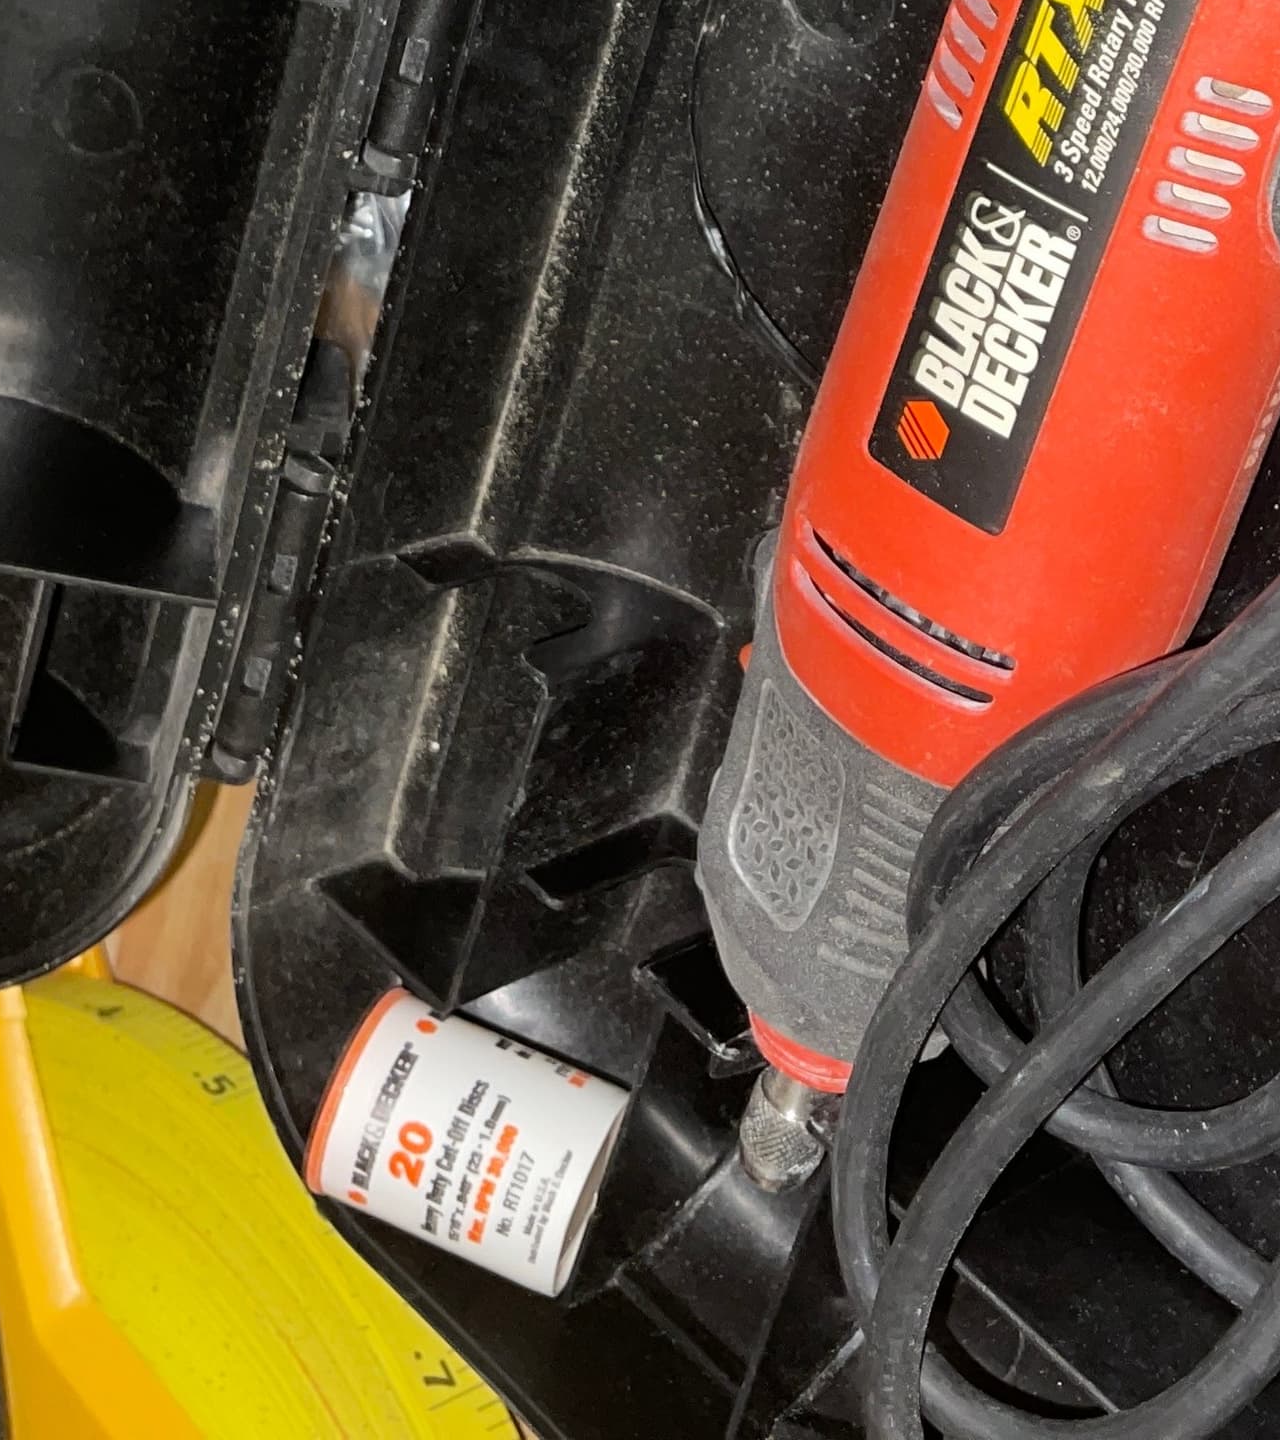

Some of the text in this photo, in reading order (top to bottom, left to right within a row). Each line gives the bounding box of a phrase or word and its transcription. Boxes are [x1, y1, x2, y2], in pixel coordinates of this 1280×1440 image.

[1089, 9, 1132, 88] Rotary
[1061, 85, 1101, 163] Speed
[1082, 19, 1157, 194] 12,000/24,000/30,000
[1054, 161, 1073, 183] 3
[389, 1121, 433, 1188] 20
[503, 1151, 534, 1212] RT1017
